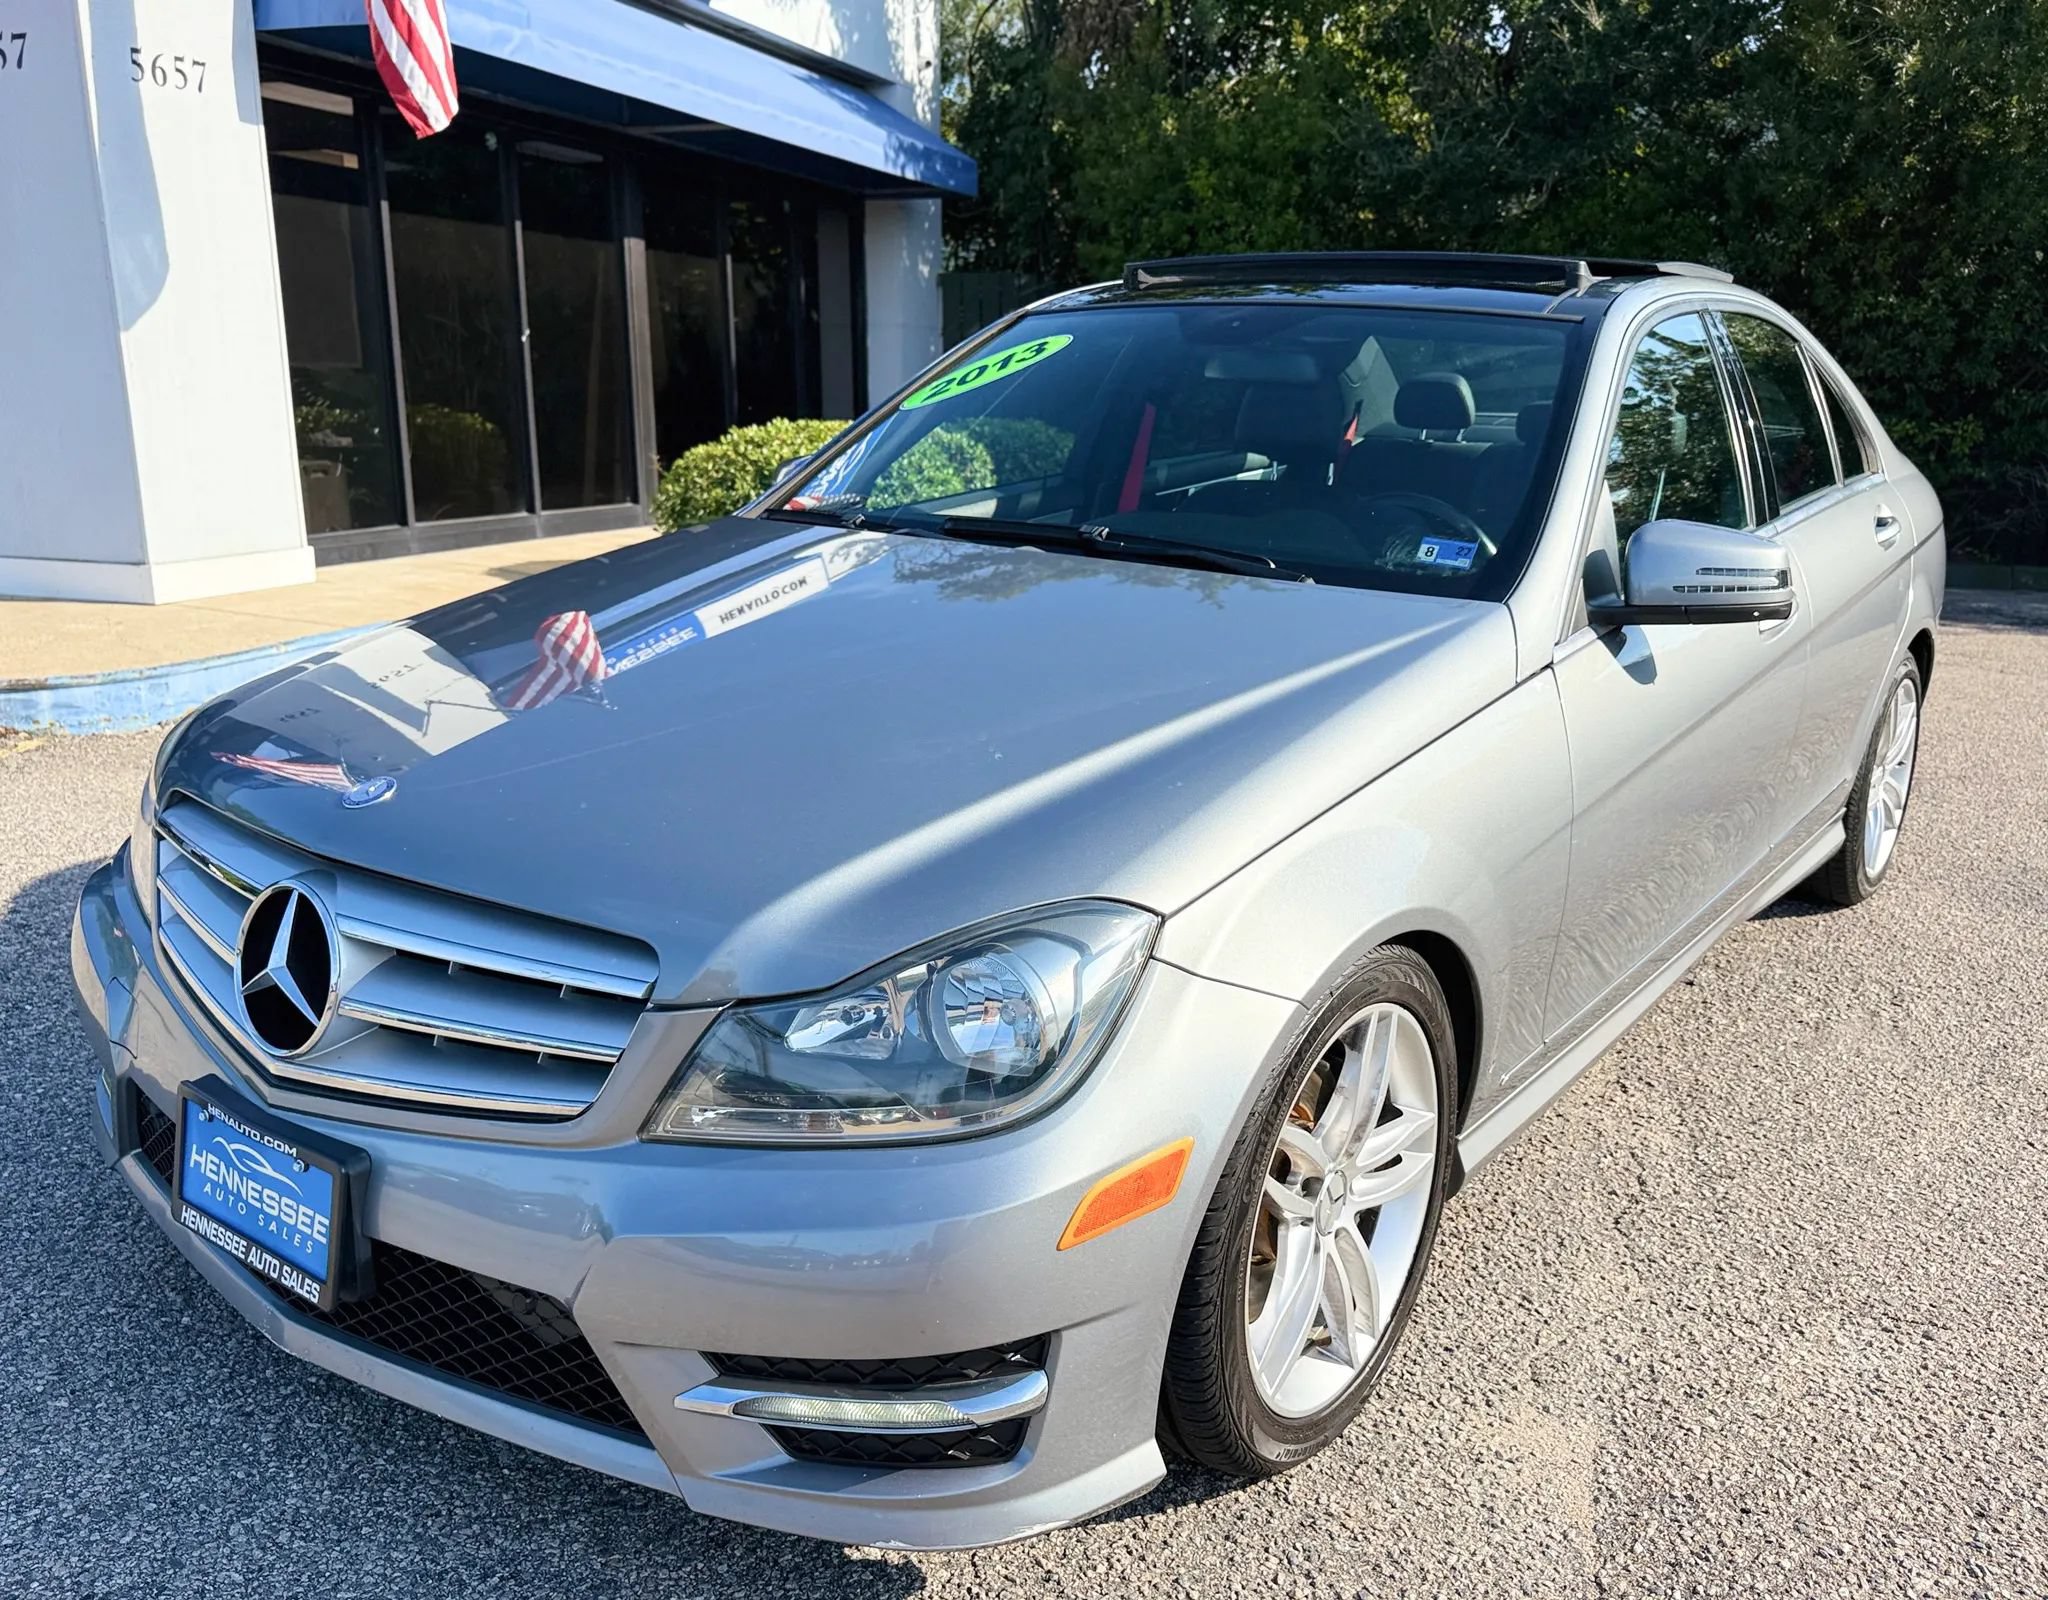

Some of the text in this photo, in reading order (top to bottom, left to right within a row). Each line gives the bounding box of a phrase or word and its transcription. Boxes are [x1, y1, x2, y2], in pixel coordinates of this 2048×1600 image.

[130, 47, 206, 93] 5657
[920, 341, 1051, 403] 2013
[1425, 546, 1435, 557] 8
[208, 1103, 297, 1157] HENAUTO.COM
[189, 1144, 329, 1244] HENNESSEE
[203, 1182, 314, 1254] AUTO SALES
[181, 1205, 320, 1304] HENNESSEE AUTO SALES
